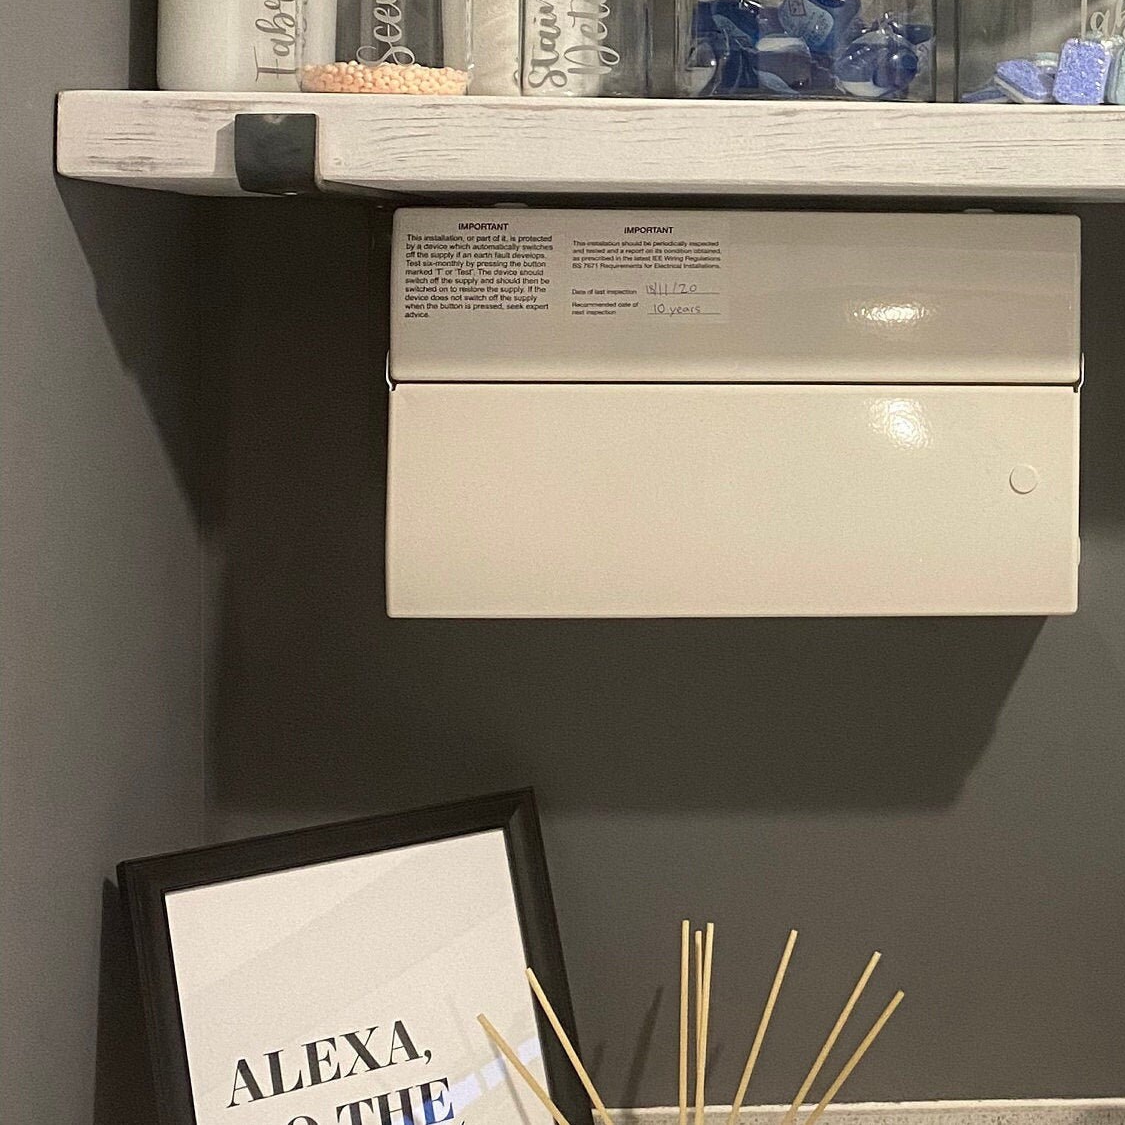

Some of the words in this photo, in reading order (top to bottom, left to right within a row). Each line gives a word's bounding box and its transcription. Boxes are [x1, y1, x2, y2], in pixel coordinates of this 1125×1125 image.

[458, 223, 509, 231] IMPORTANT
[405, 277, 428, 285] switch
[430, 277, 439, 285] off
[441, 277, 452, 285] the
[455, 277, 478, 285] supply
[481, 277, 494, 285] and
[496, 277, 520, 285] should
[523, 277, 538, 285] then
[541, 277, 550, 285] be
[654, 304, 665, 313] 10
[669, 306, 700, 317] years
[226, 1020, 433, 1109] ALEXA,
[337, 1077, 454, 1125] THE
